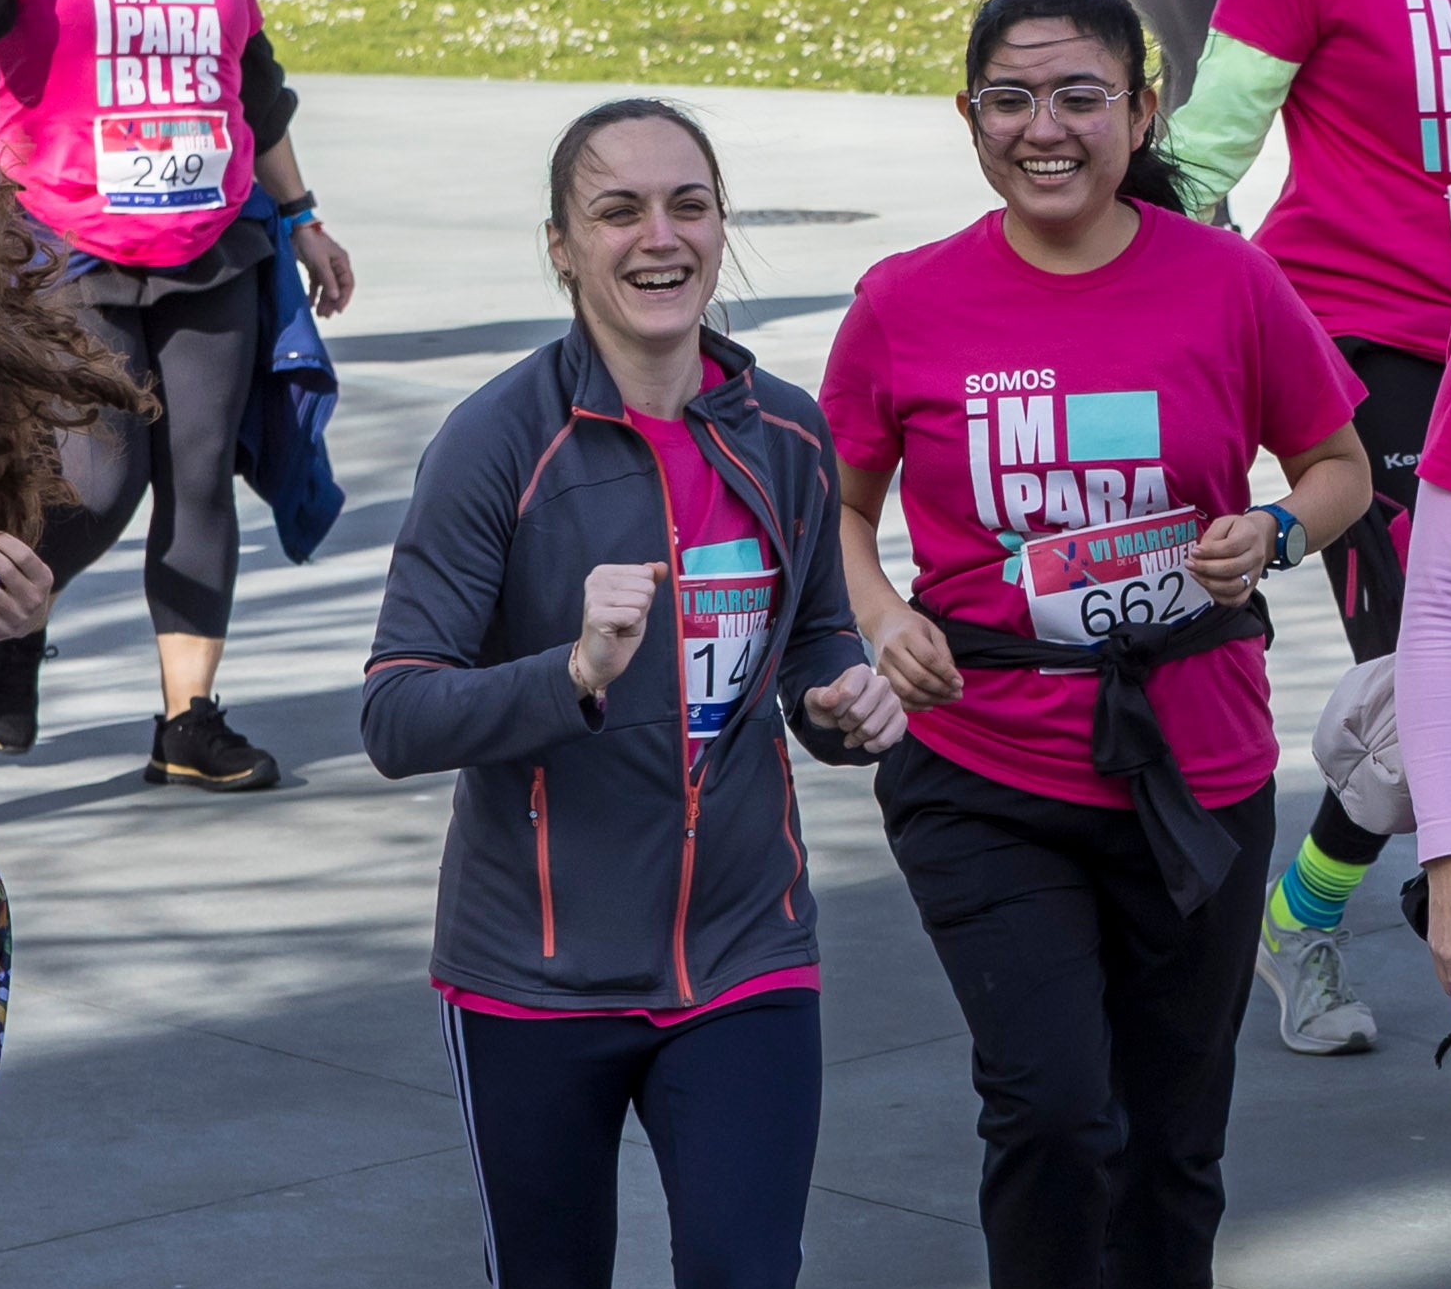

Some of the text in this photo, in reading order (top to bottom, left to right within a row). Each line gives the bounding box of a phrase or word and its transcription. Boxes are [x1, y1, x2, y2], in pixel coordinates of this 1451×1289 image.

[116, 6, 222, 55] PARA
[116, 55, 222, 106] BLES
[133, 154, 204, 187] 249
[965, 369, 1056, 394] SOMOS
[1001, 467, 1170, 533] PARA
[1087, 519, 1198, 563] VI MARCHA
[695, 586, 772, 614] MARCHA
[1081, 571, 1186, 637] 662
[718, 610, 770, 639] MUJER
